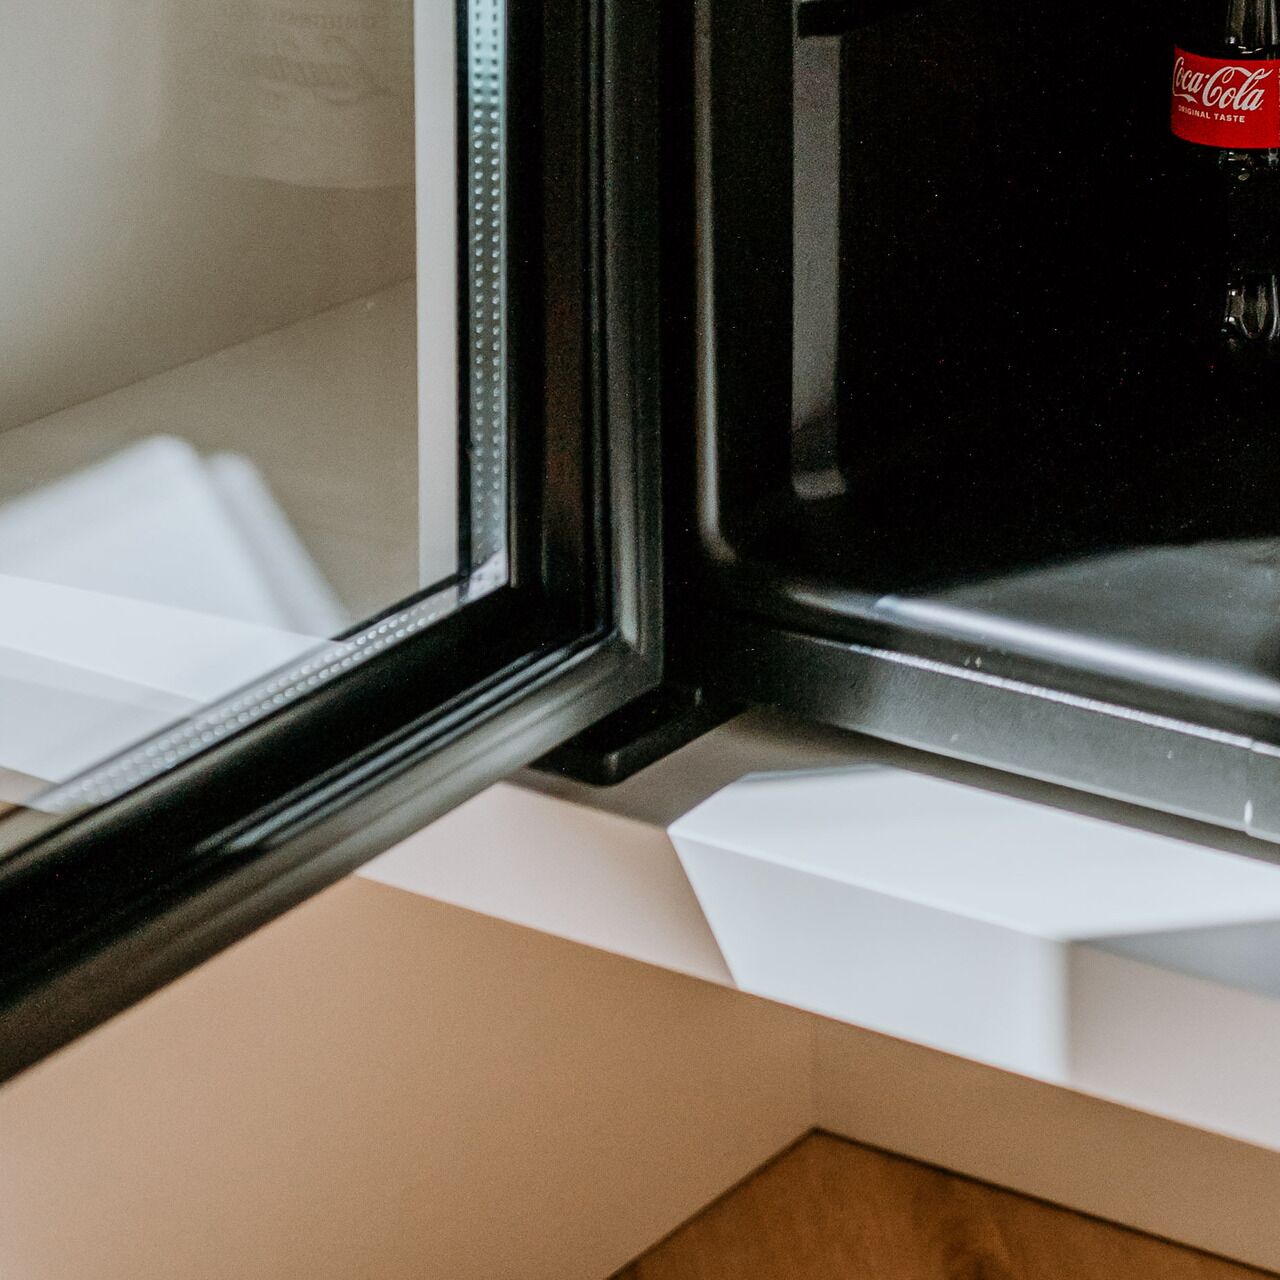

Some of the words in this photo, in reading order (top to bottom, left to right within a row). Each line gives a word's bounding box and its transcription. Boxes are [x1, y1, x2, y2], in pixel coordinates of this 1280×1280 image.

[1172, 56, 1274, 112] Coca-Cola
[1178, 104, 1211, 119] ORIGINAL
[1213, 112, 1245, 123] TASTE
